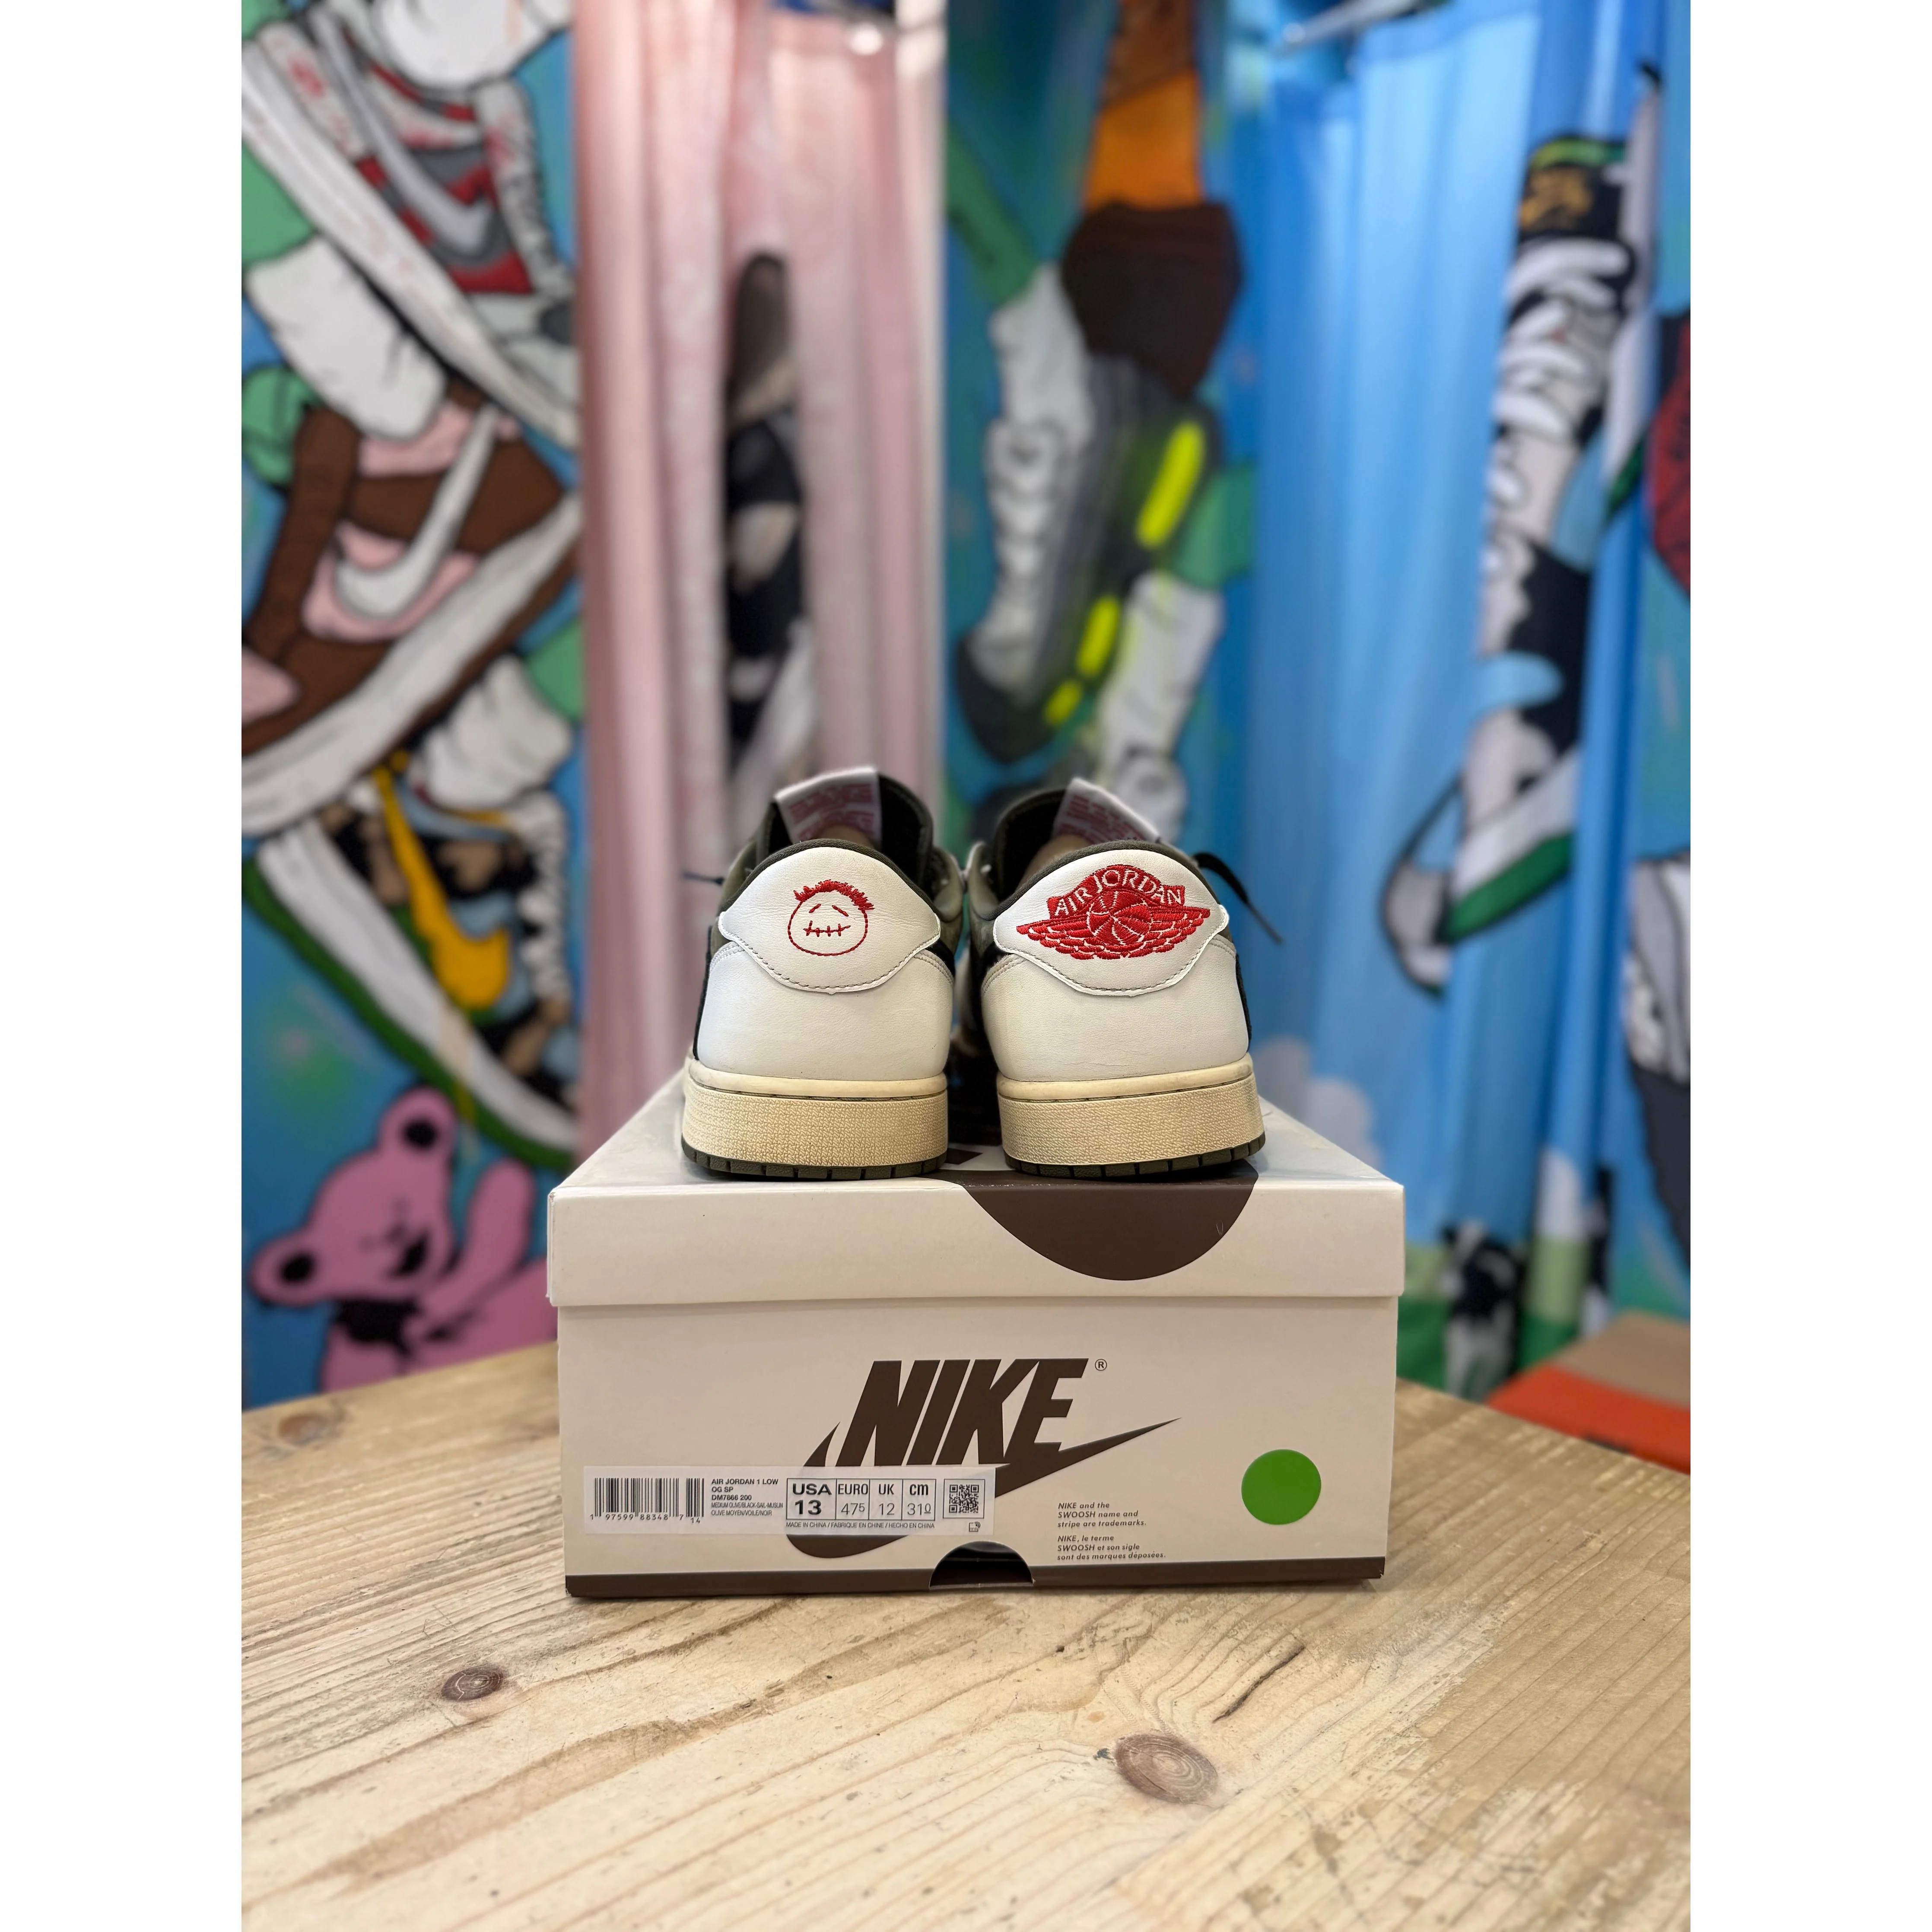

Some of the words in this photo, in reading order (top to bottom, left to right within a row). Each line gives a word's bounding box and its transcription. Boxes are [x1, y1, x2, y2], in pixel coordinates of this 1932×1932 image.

[1054, 887, 1093, 917] AIR
[1091, 869, 1182, 905] JORDAN
[836, 1358, 1089, 1467] NIKE
[793, 1484, 832, 1495] USA
[838, 1484, 868, 1494] EURO
[879, 1484, 894, 1494] UK
[909, 1484, 928, 1495] cm
[795, 1500, 822, 1515] 13
[879, 1503, 895, 1515] 12
